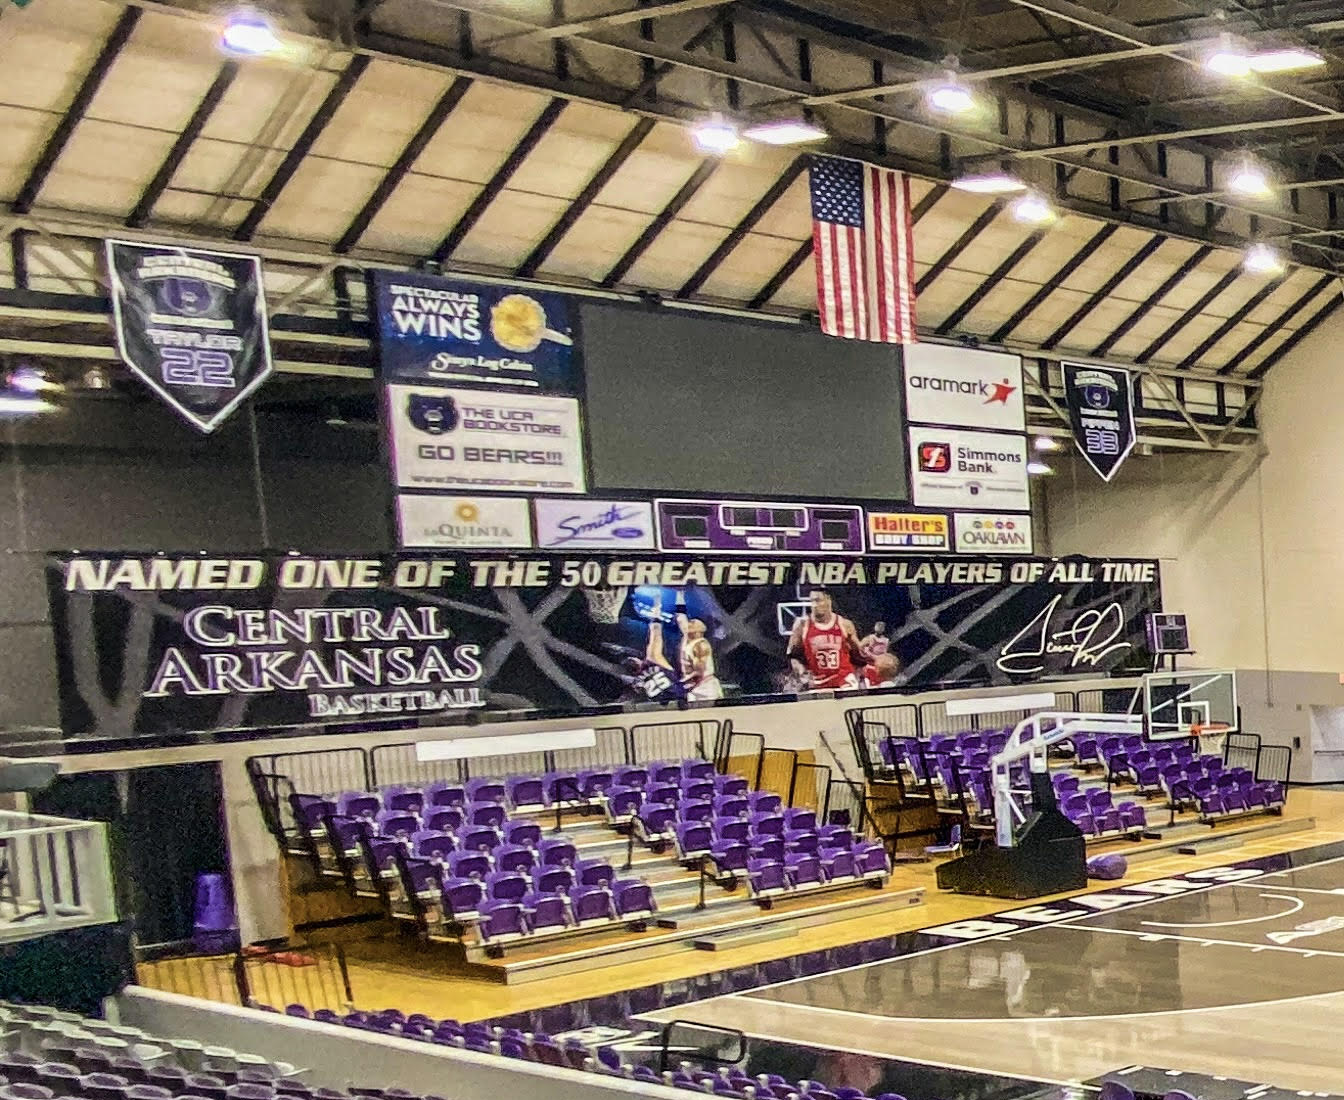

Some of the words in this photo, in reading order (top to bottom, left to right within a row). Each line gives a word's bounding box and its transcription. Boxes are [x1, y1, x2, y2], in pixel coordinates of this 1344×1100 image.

[392, 296, 480, 319] ALWAYS
[393, 310, 482, 341] WINS
[160, 348, 236, 387] 22
[910, 375, 988, 396] aramark
[462, 407, 495, 419] THE
[500, 409, 533, 421] UCA
[464, 421, 561, 435] BOOKSTORE
[418, 445, 455, 461] GO
[464, 447, 563, 465] BEARS!!!
[957, 447, 1021, 463] Simmons
[957, 460, 994, 474] Bank
[874, 517, 944, 532] Halter's
[962, 531, 1025, 545] OAKLAWN
[66, 560, 264, 591] NAMED
[279, 560, 382, 589] ONE
[395, 561, 456, 588] OF
[470, 561, 550, 587] THE
[561, 561, 600, 587] 50
[607, 561, 791, 586] GREATEST
[800, 562, 867, 585] NBA
[876, 562, 1003, 584] PLAYERS
[1010, 562, 1044, 584] OF
[1049, 562, 1095, 583] ALL
[1101, 562, 1155, 583] TIME
[183, 605, 450, 647] CENTRAL
[142, 643, 485, 698] ARKANSAS
[644, 671, 671, 698] 25
[308, 687, 487, 718] BASKETBALL
[918, 866, 1265, 939] BEARS
